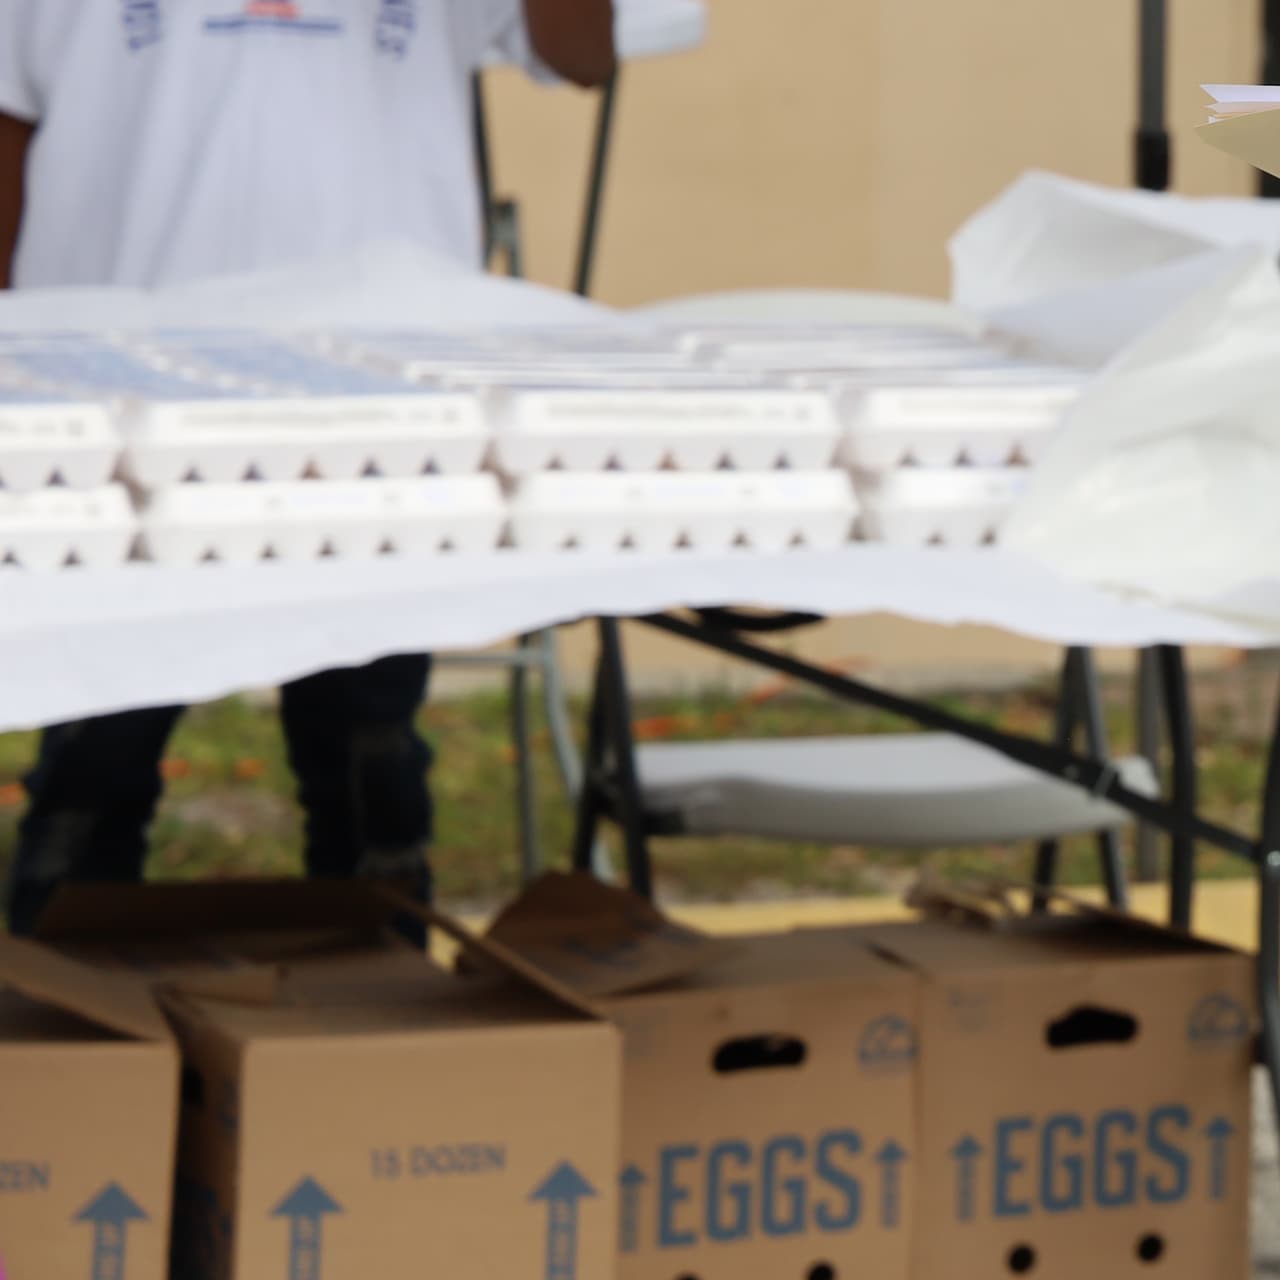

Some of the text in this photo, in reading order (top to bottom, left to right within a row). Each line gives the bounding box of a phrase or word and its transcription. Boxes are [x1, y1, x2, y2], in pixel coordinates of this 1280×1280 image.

[409, 1142, 509, 1179] DOZEN
[656, 1129, 864, 1250] EGGS
[993, 1104, 1193, 1218] EGGS
